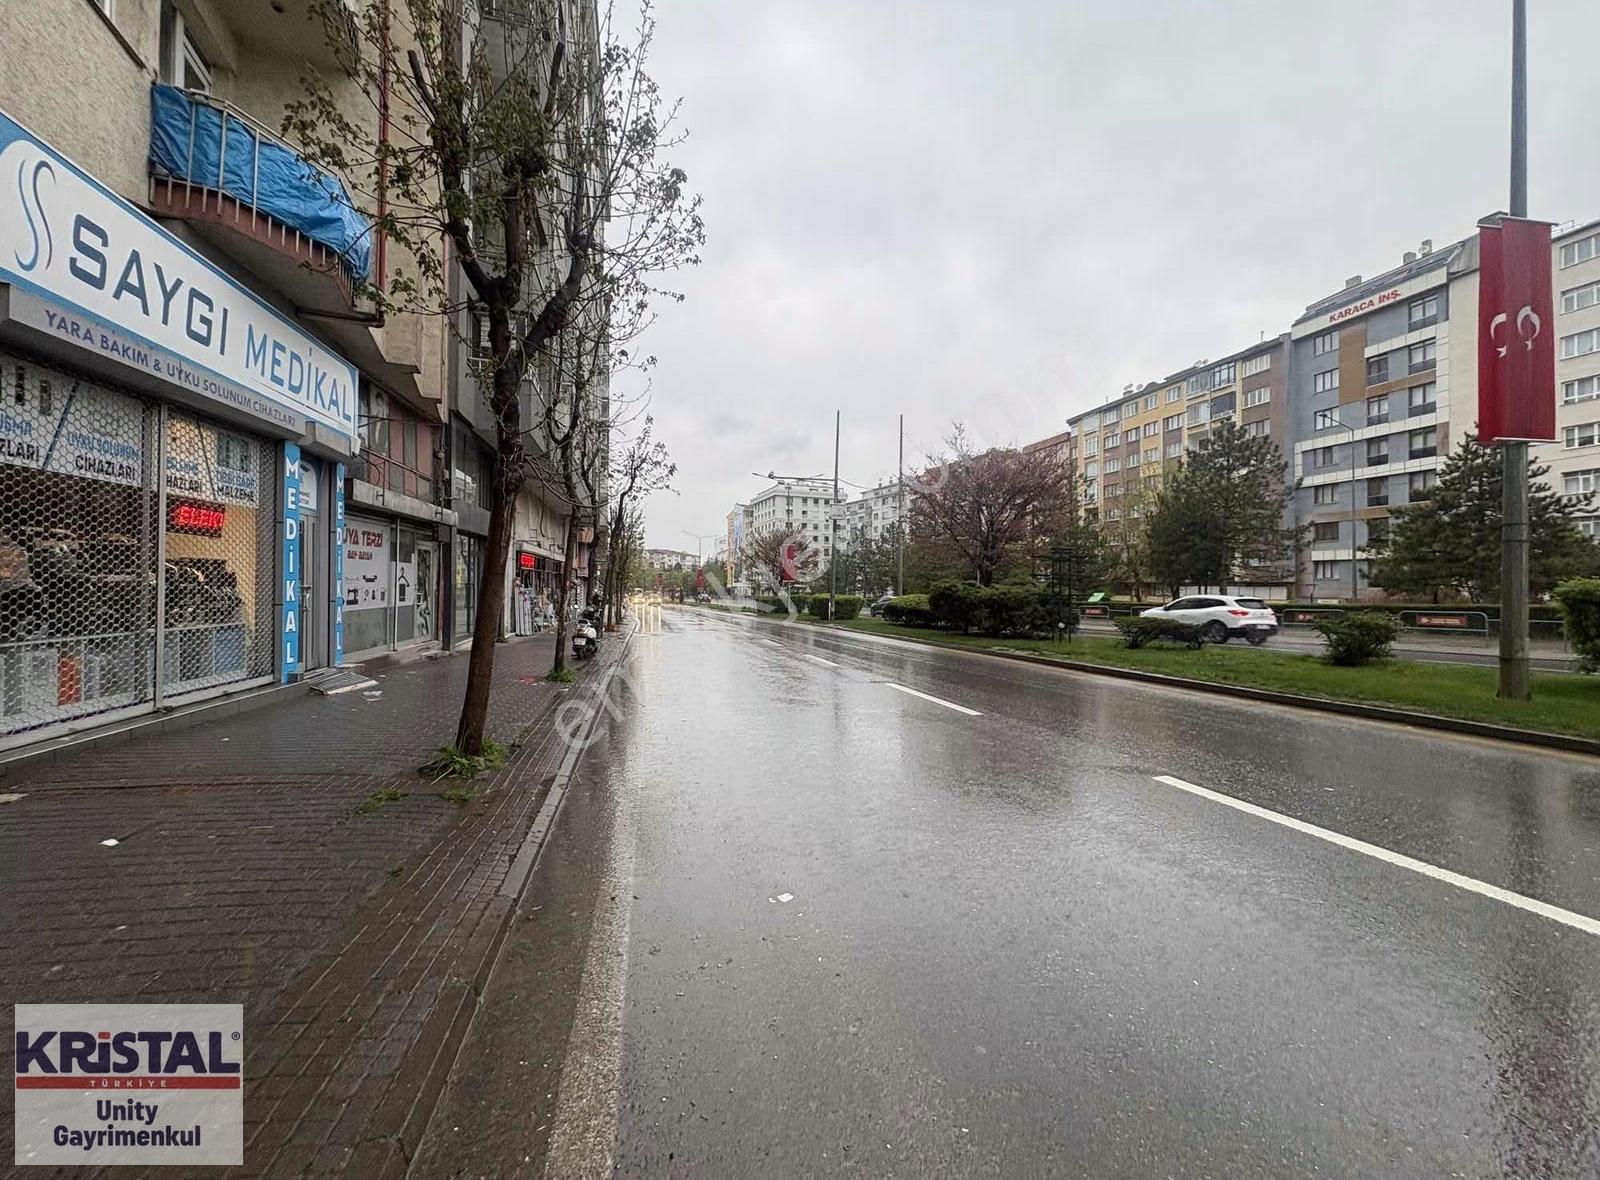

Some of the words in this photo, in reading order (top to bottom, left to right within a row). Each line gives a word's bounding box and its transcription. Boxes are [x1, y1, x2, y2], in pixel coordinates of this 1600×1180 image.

[45, 309, 95, 345] YARA
[100, 334, 149, 368] BAKIM
[153, 359, 162, 374] &
[167, 363, 200, 387] UYKU
[203, 379, 251, 409] SOLUNUM
[69, 214, 228, 356] SAYGI
[245, 323, 351, 422] MEDİKAL
[1329, 300, 1375, 323] KARACA
